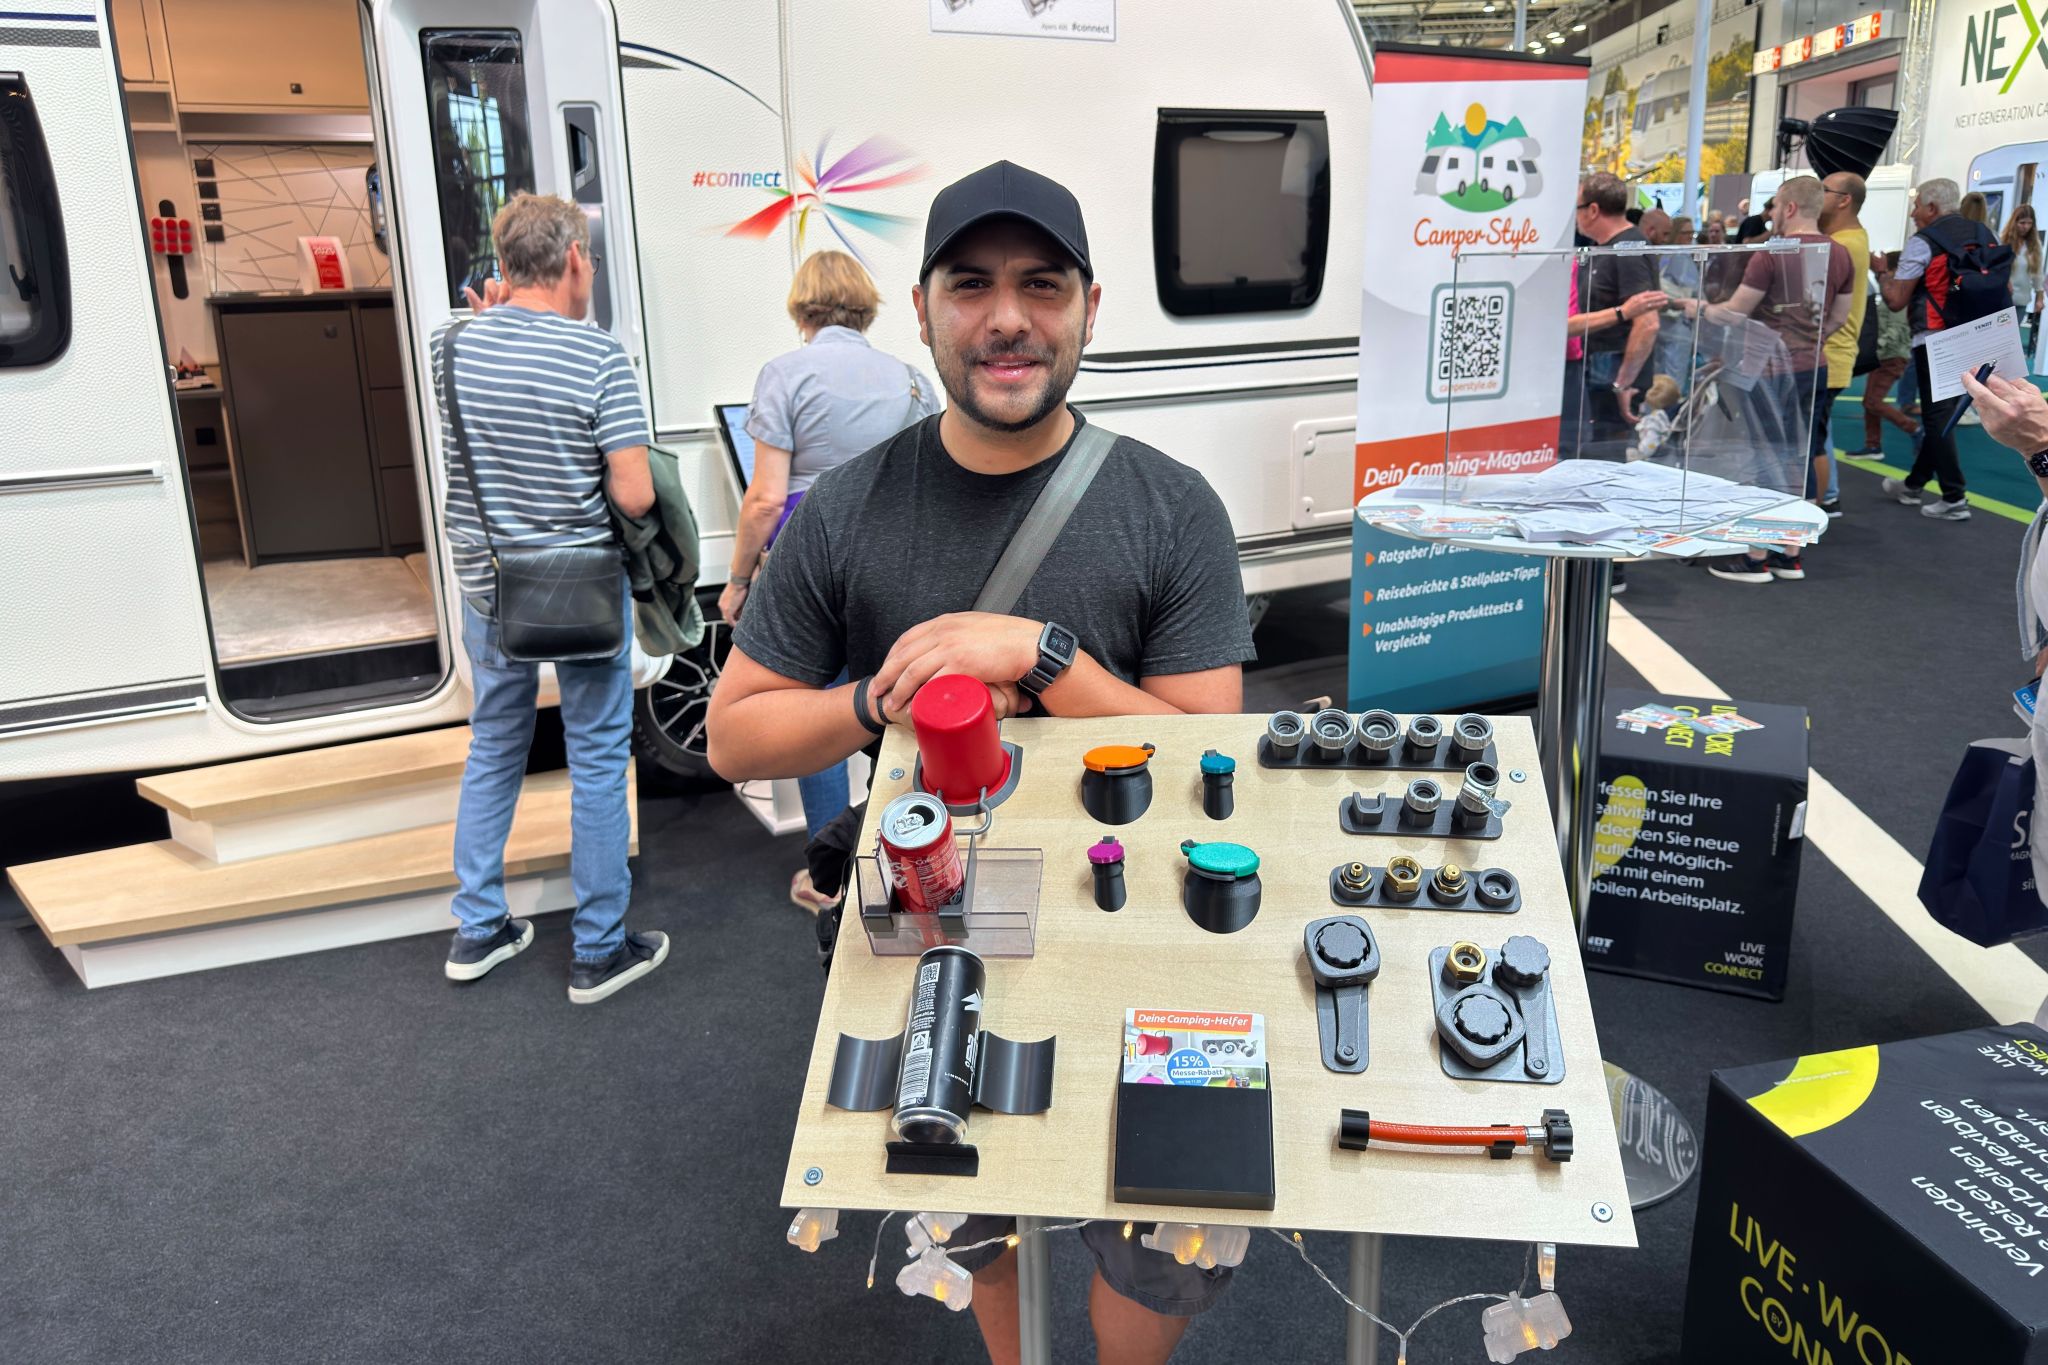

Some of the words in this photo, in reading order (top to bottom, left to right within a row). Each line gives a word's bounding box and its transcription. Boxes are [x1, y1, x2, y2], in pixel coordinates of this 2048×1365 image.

[1954, 112, 1977, 128] NEXT
[1978, 104, 2034, 125] GENERATION
[693, 170, 782, 187] #connect
[1363, 463, 1404, 487] Dein
[1378, 545, 1429, 564] Ratgeber
[1429, 543, 1447, 559] für
[1376, 576, 1449, 602] Reiseberichte
[1450, 577, 1458, 590] &
[1460, 565, 1541, 588] Stellplatz-Tipps
[1375, 612, 1446, 634] Unabhängige
[1447, 601, 1514, 623] Produkttests
[1515, 598, 1524, 611] &
[1375, 632, 1432, 653] Vergleiche
[1704, 733, 1735, 757] ORK
[1598, 781, 1658, 801] fesseln
[1660, 790, 1686, 806] Sie
[1689, 793, 1723, 810] Ihre
[1659, 812, 1693, 826] und
[1666, 831, 1691, 847] Sie
[1694, 837, 1740, 852] neue
[1595, 842, 1655, 861] rufliche
[1658, 850, 1733, 871] Möglich-
[1623, 866, 1649, 880] mit
[1651, 870, 1704, 888] einem
[1640, 887, 1745, 914] Arbeitsplatz.
[1724, 951, 1764, 967] WORK
[1741, 941, 1766, 955] LIVE
[1704, 961, 1763, 980] CONNECT
[1138, 1014, 1166, 1024] Deine
[1167, 1014, 1248, 1027] Camping-Helfer
[1173, 1055, 1204, 1068] 15%
[1977, 1045, 2016, 1068] LIVE
[1172, 1069, 1223, 1077] Messe-Rabatt
[1920, 1099, 2024, 1167] flexiblen
[1955, 1178, 2042, 1238] Reisen
[1911, 1176, 2045, 1278] Verbinden
[1730, 1201, 1796, 1293] LIVE
